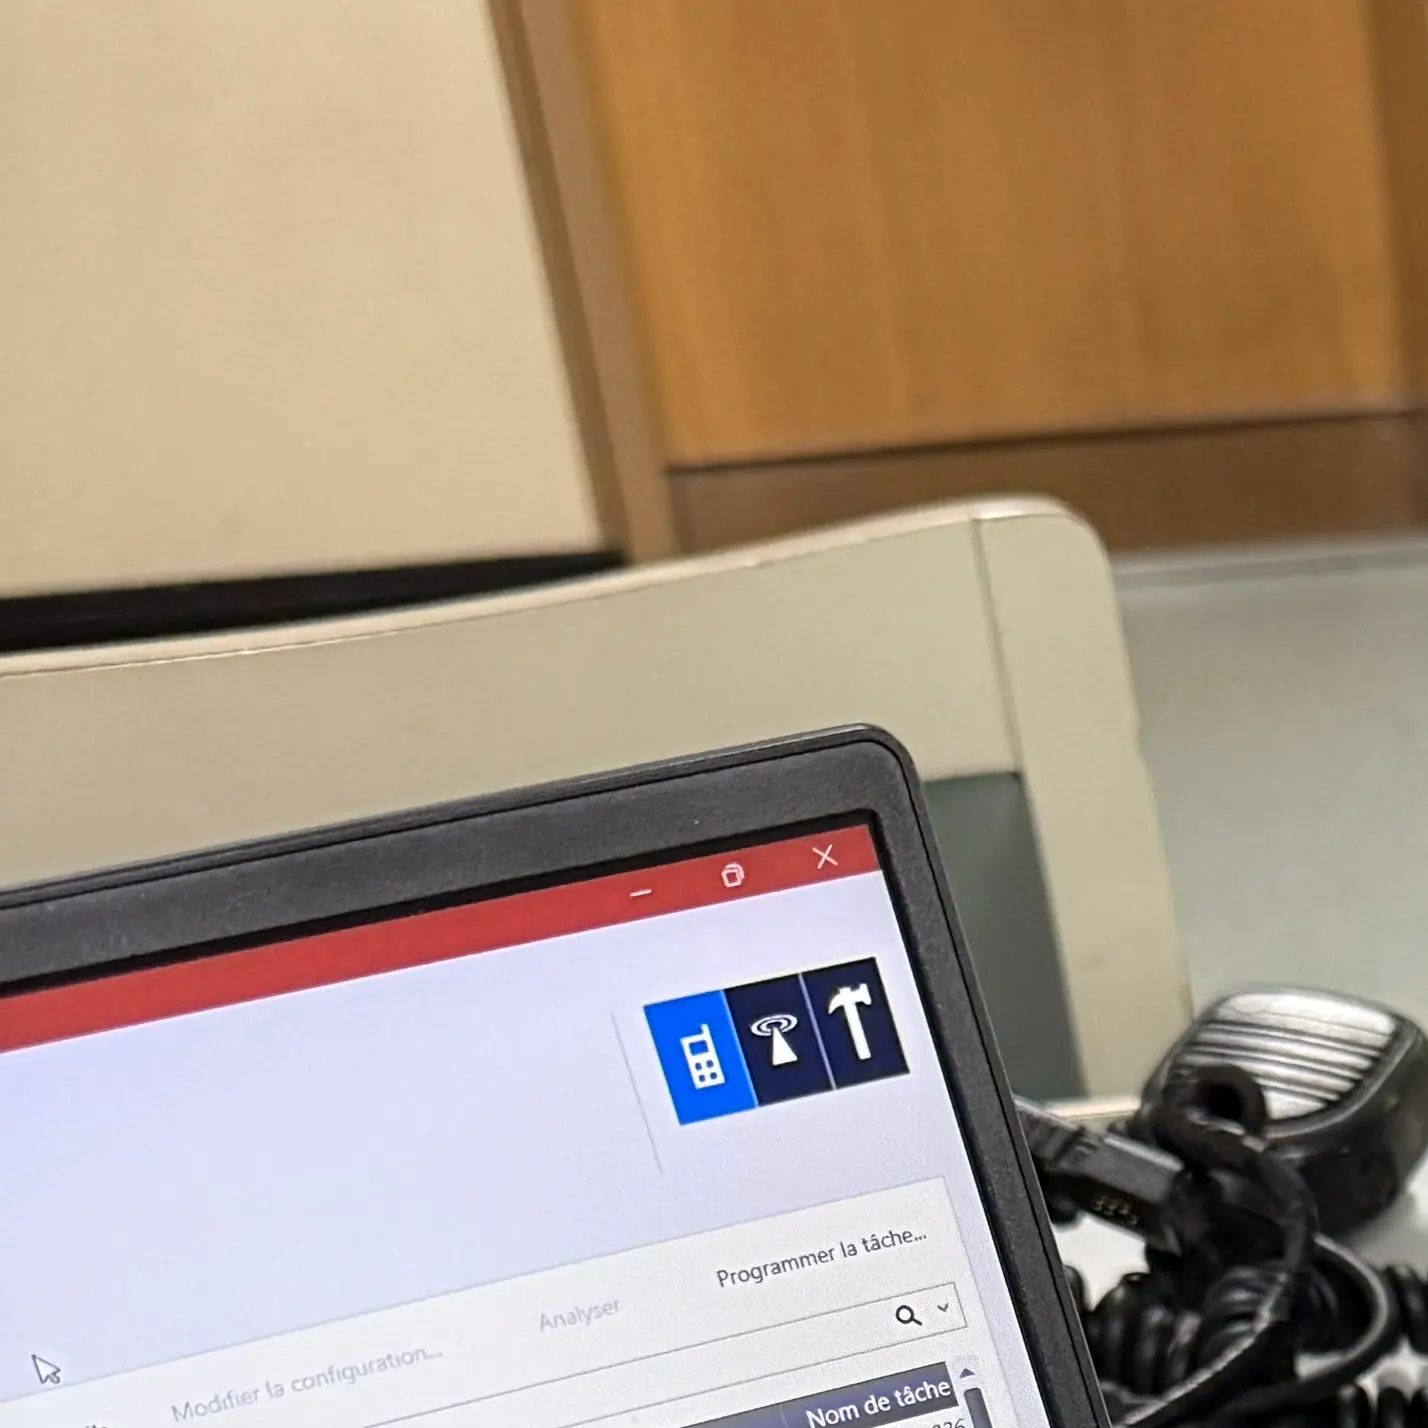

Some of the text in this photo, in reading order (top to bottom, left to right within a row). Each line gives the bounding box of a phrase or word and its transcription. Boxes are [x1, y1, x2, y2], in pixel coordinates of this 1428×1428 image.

[715, 1226, 927, 1292] Programmer la tâche...
[538, 1296, 621, 1335] Analyser
[170, 1344, 444, 1423] Modifier la configuration...
[864, 1393, 892, 1414] de
[898, 1379, 951, 1406] tâche
